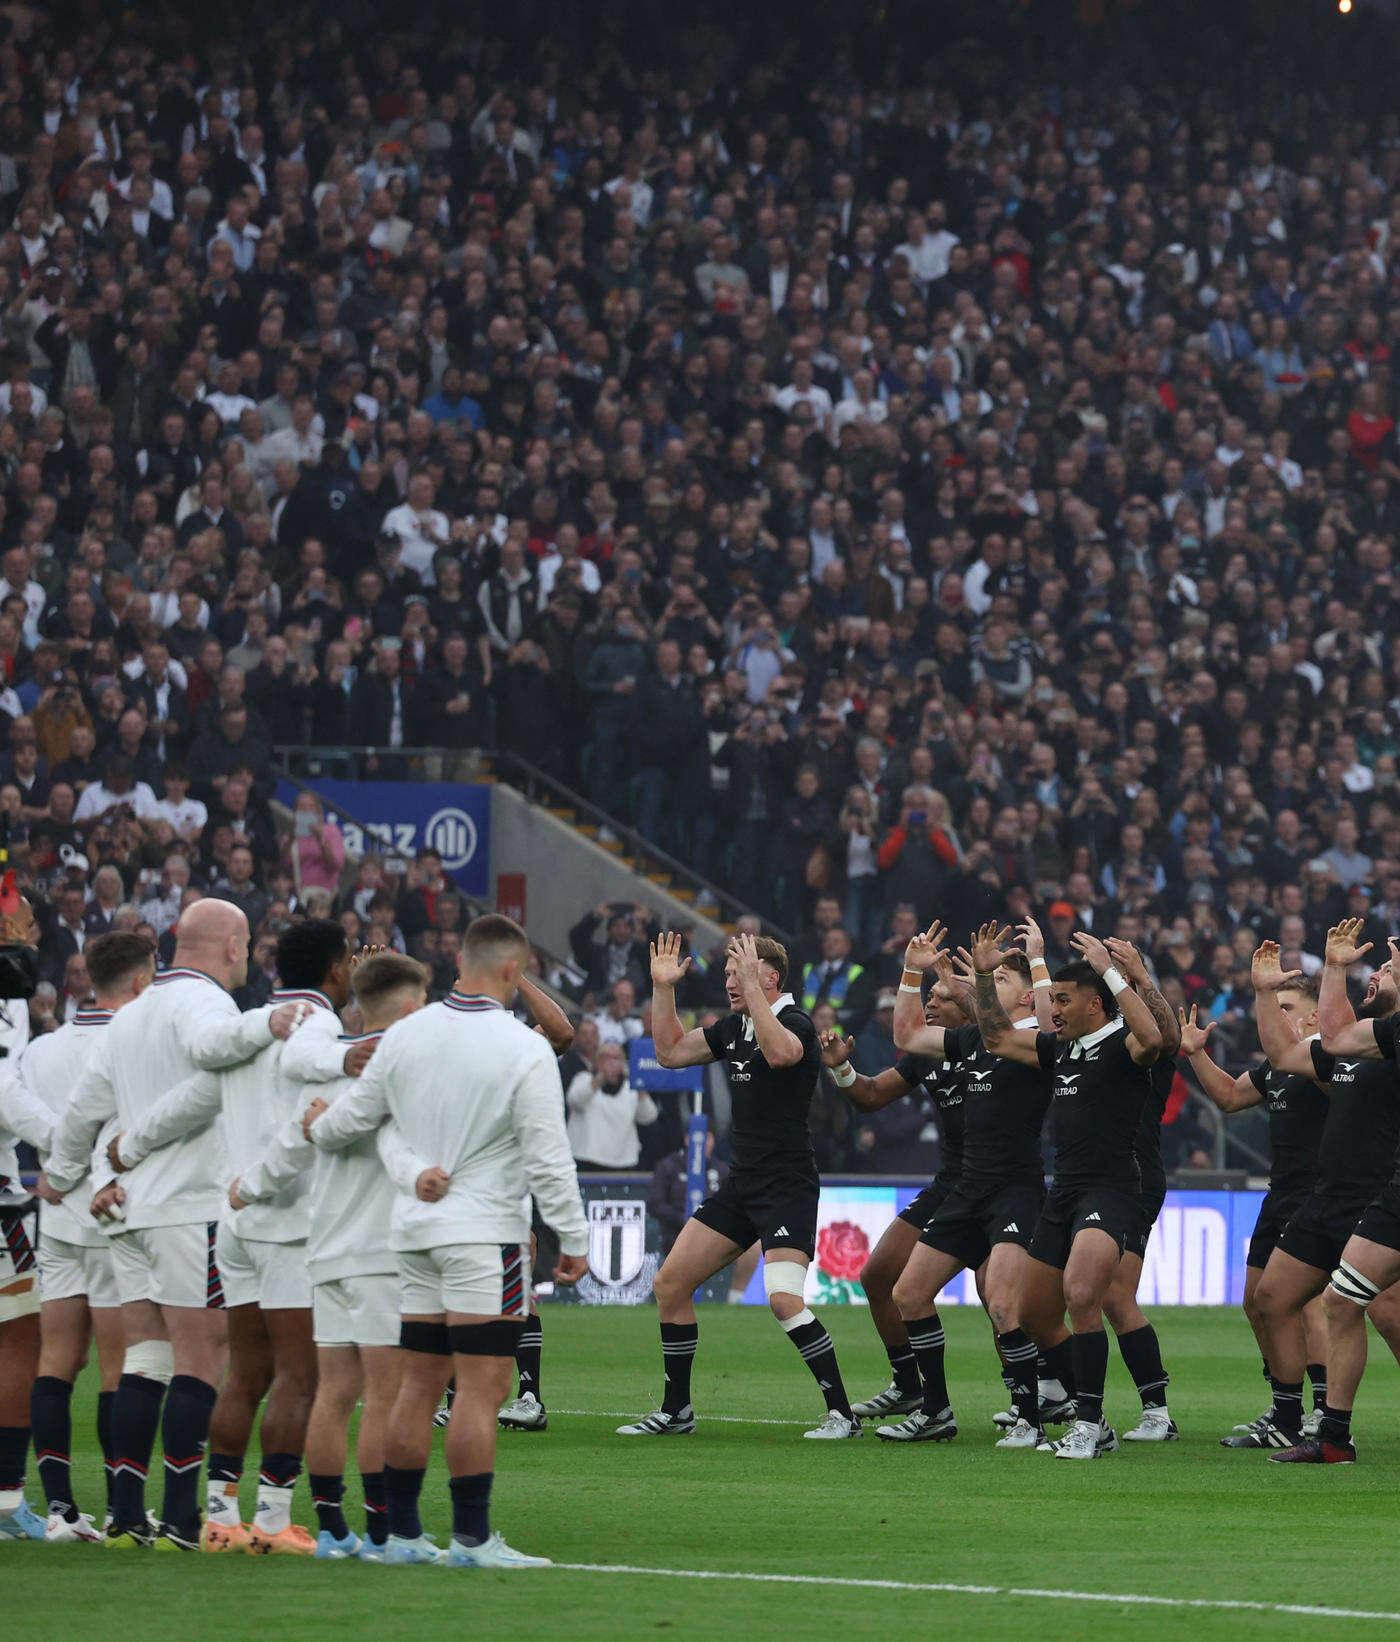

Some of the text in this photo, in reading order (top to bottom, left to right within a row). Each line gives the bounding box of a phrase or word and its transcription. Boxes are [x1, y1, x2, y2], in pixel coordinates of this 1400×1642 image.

[1331, 1073, 1355, 1082] ALTRAD
[967, 1083, 992, 1092] ALTRAD
[1054, 1086, 1078, 1096] ALTRAD
